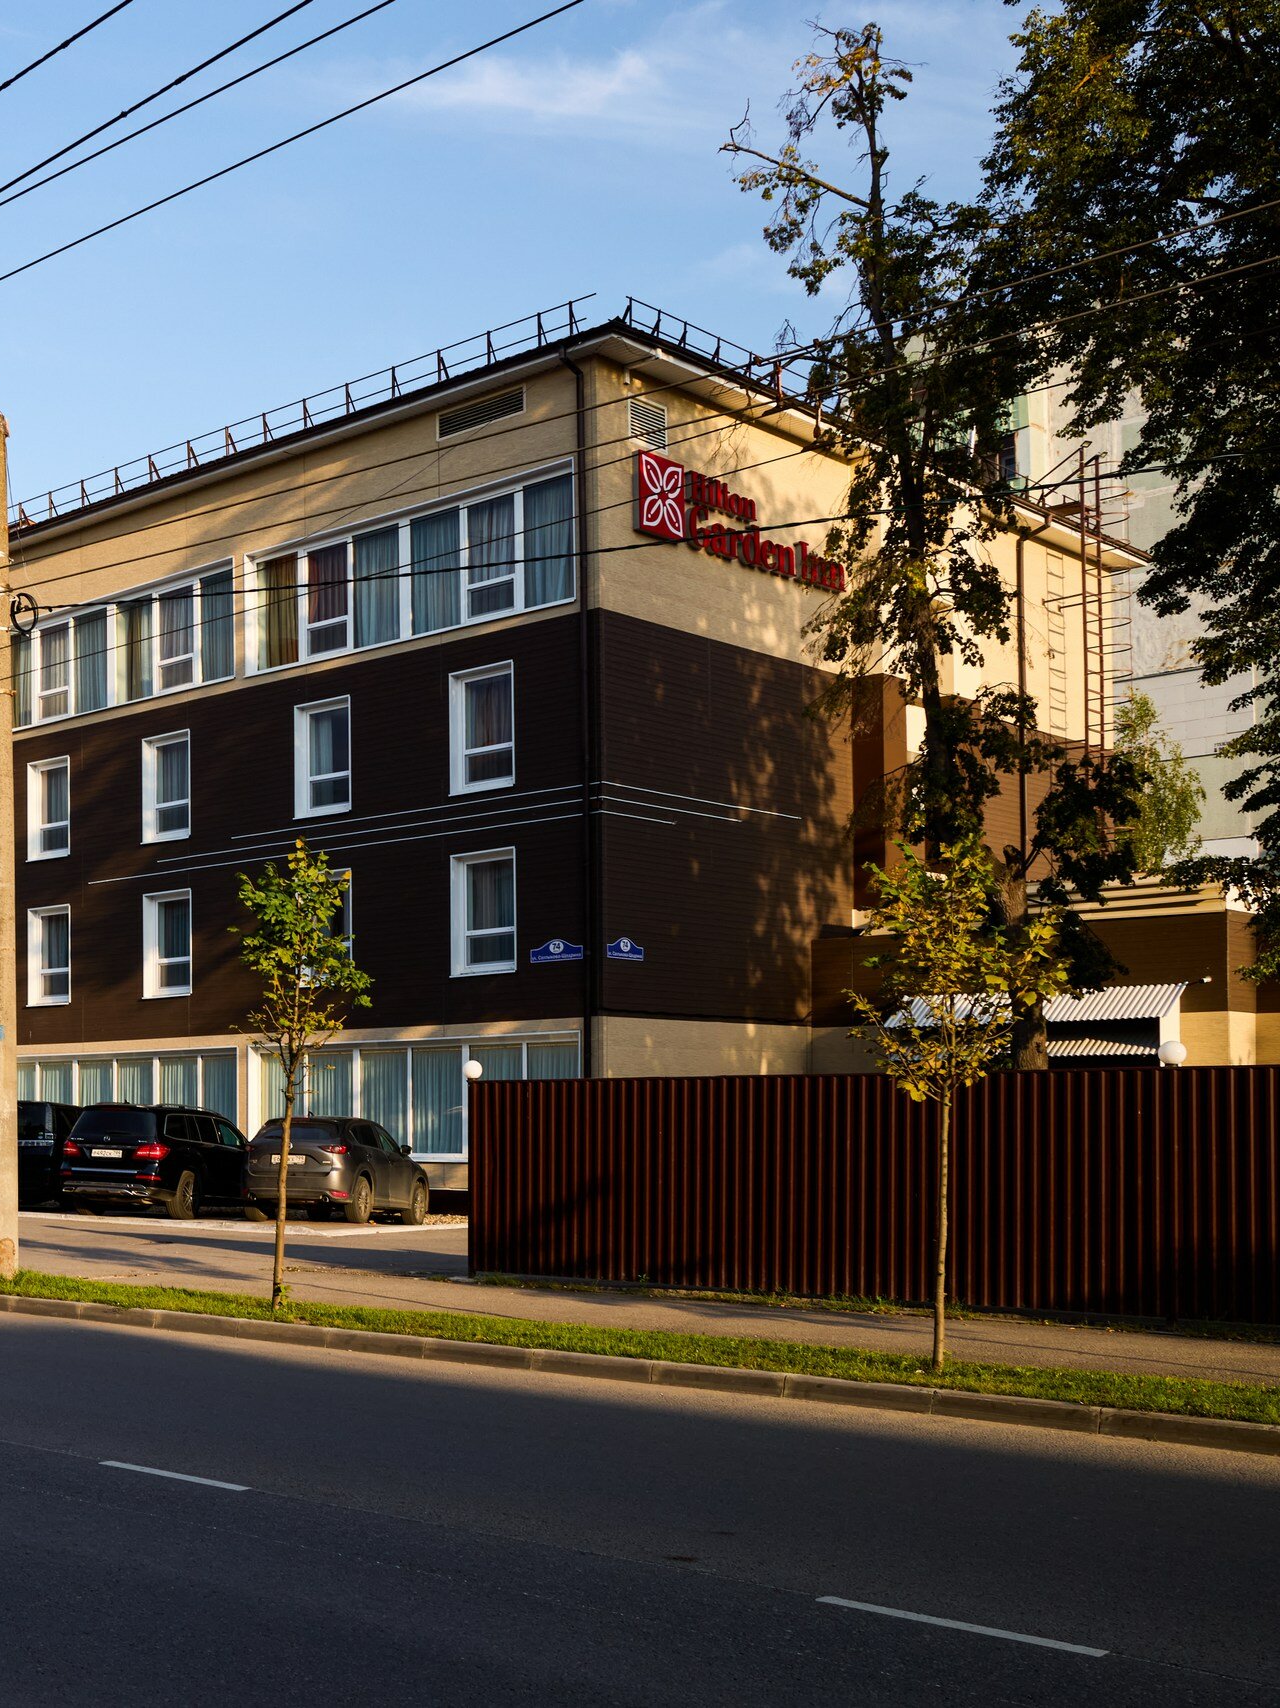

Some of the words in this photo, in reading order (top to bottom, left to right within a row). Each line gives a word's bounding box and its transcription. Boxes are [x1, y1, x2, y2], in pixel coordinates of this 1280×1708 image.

[686, 470, 757, 522] Hilton
[686, 506, 796, 578] Garden
[794, 541, 846, 592] Inn
[552, 942, 561, 951] 74
